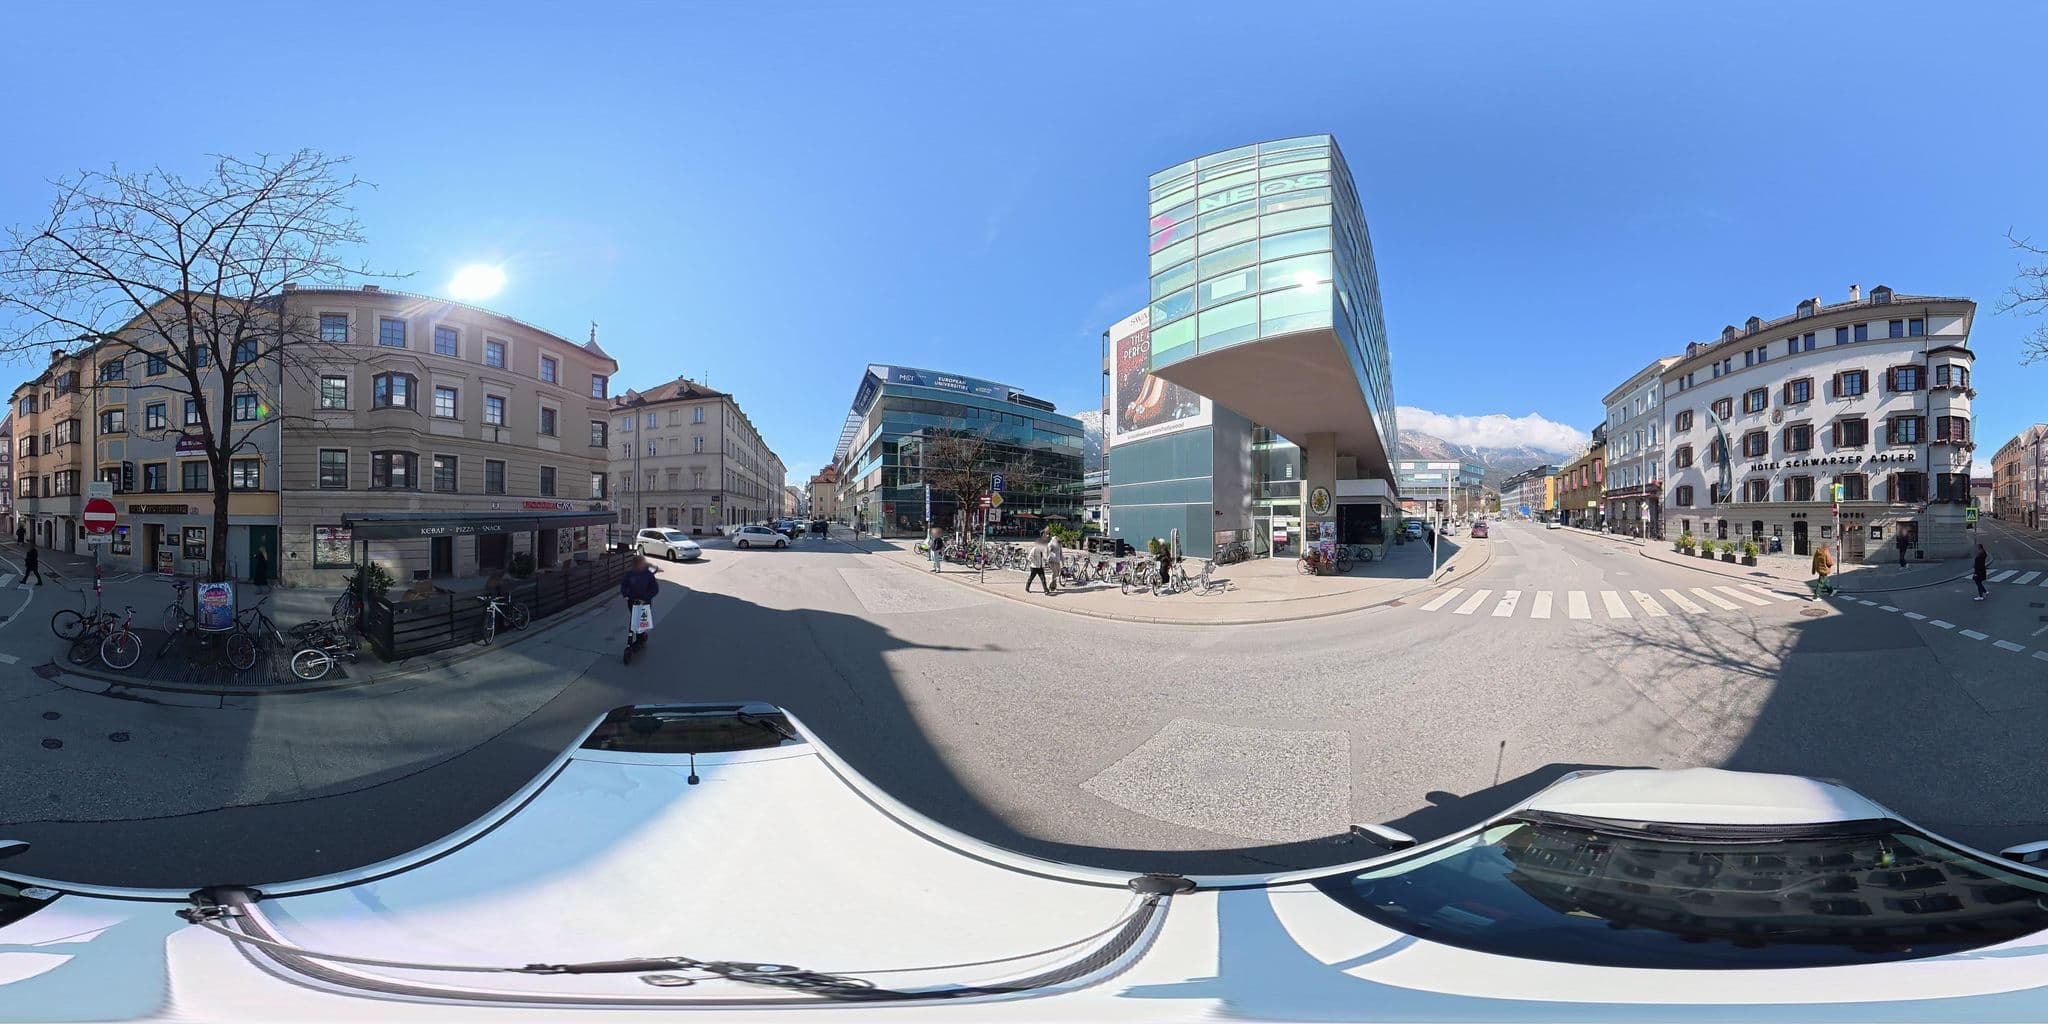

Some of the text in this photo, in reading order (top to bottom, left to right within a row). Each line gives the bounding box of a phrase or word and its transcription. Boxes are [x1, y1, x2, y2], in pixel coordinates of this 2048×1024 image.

[1130, 331, 1145, 346] THE
[934, 380, 969, 391] UNIVERSITIES
[938, 376, 967, 385] EUROPEAN
[1751, 453, 1915, 472] HOTEL SCHWARZER ADLER
[420, 527, 445, 535] KEBAP
